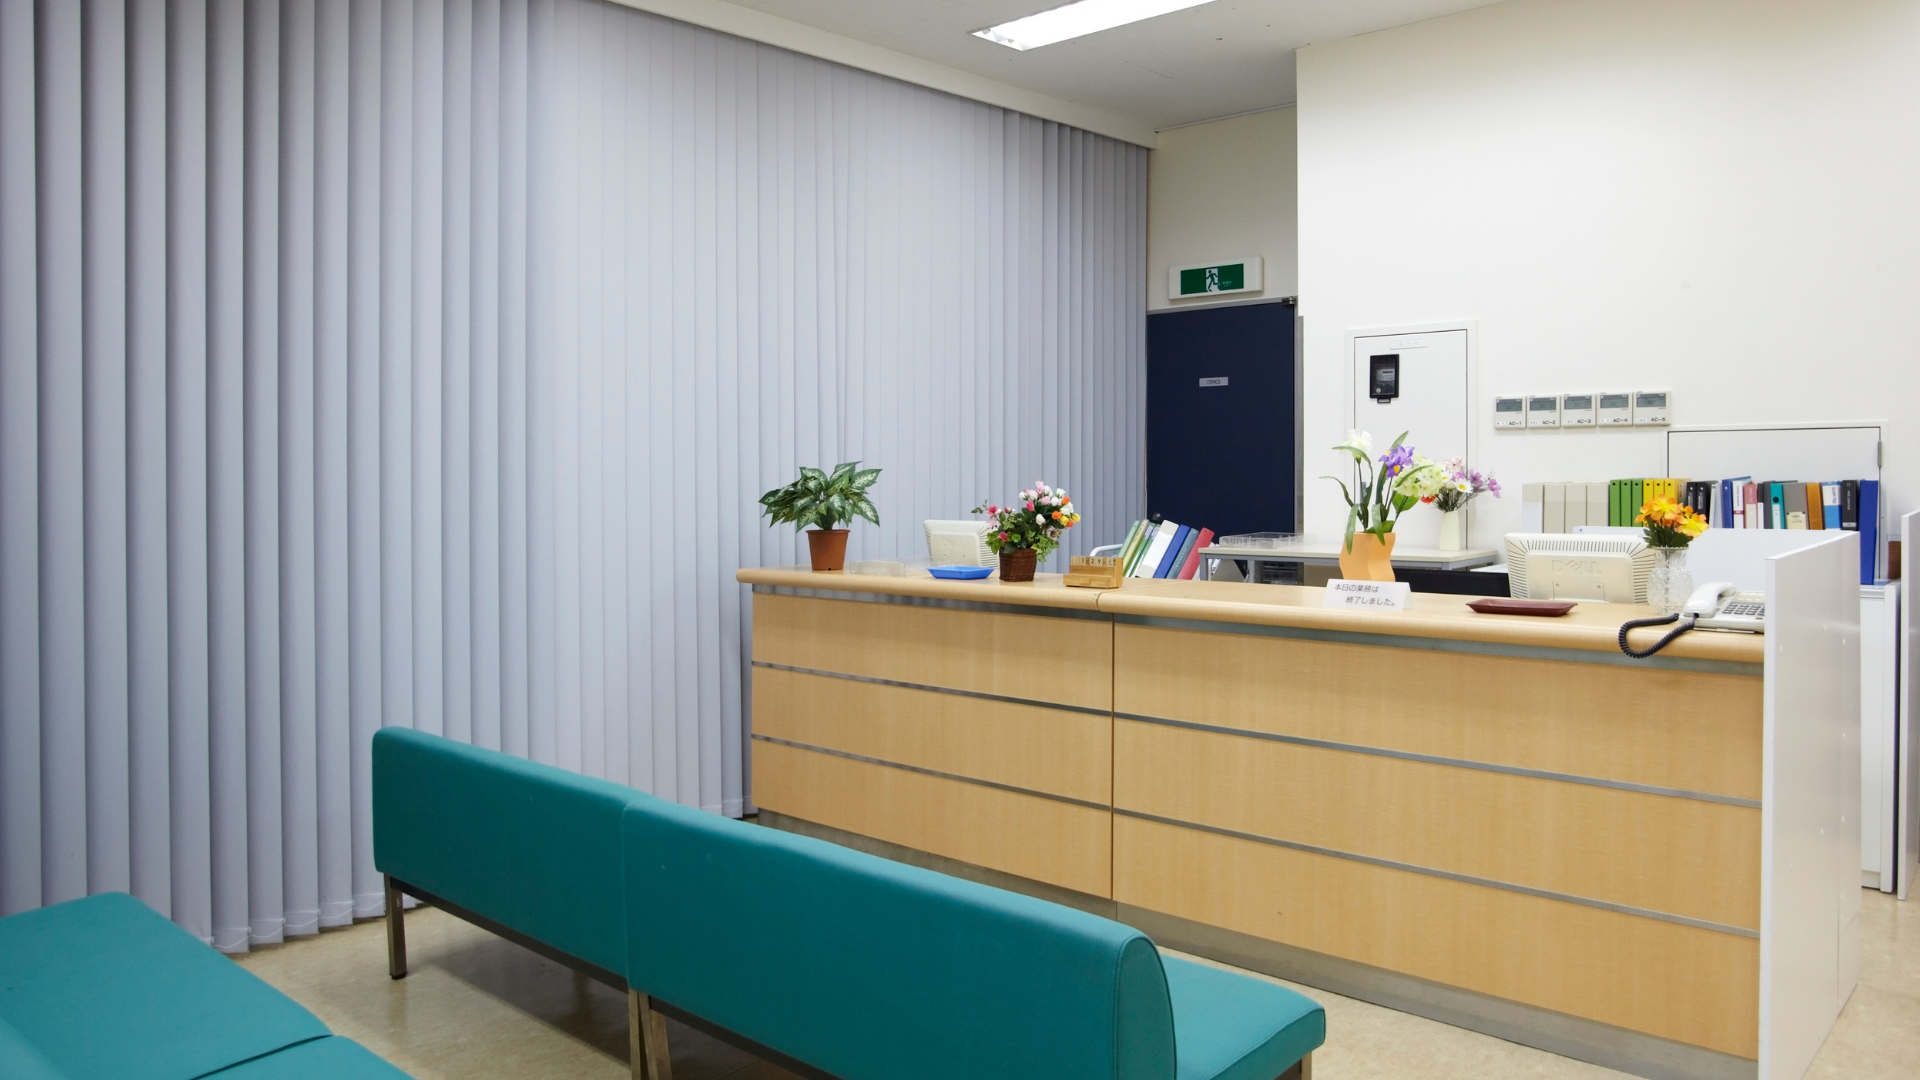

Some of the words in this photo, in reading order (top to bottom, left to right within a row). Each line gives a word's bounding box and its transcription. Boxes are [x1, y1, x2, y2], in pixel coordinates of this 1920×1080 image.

[1551, 559, 1603, 575] DELL
[1333, 583, 1379, 593] 本日の業務は
[1345, 595, 1395, 606] 終了しました。
